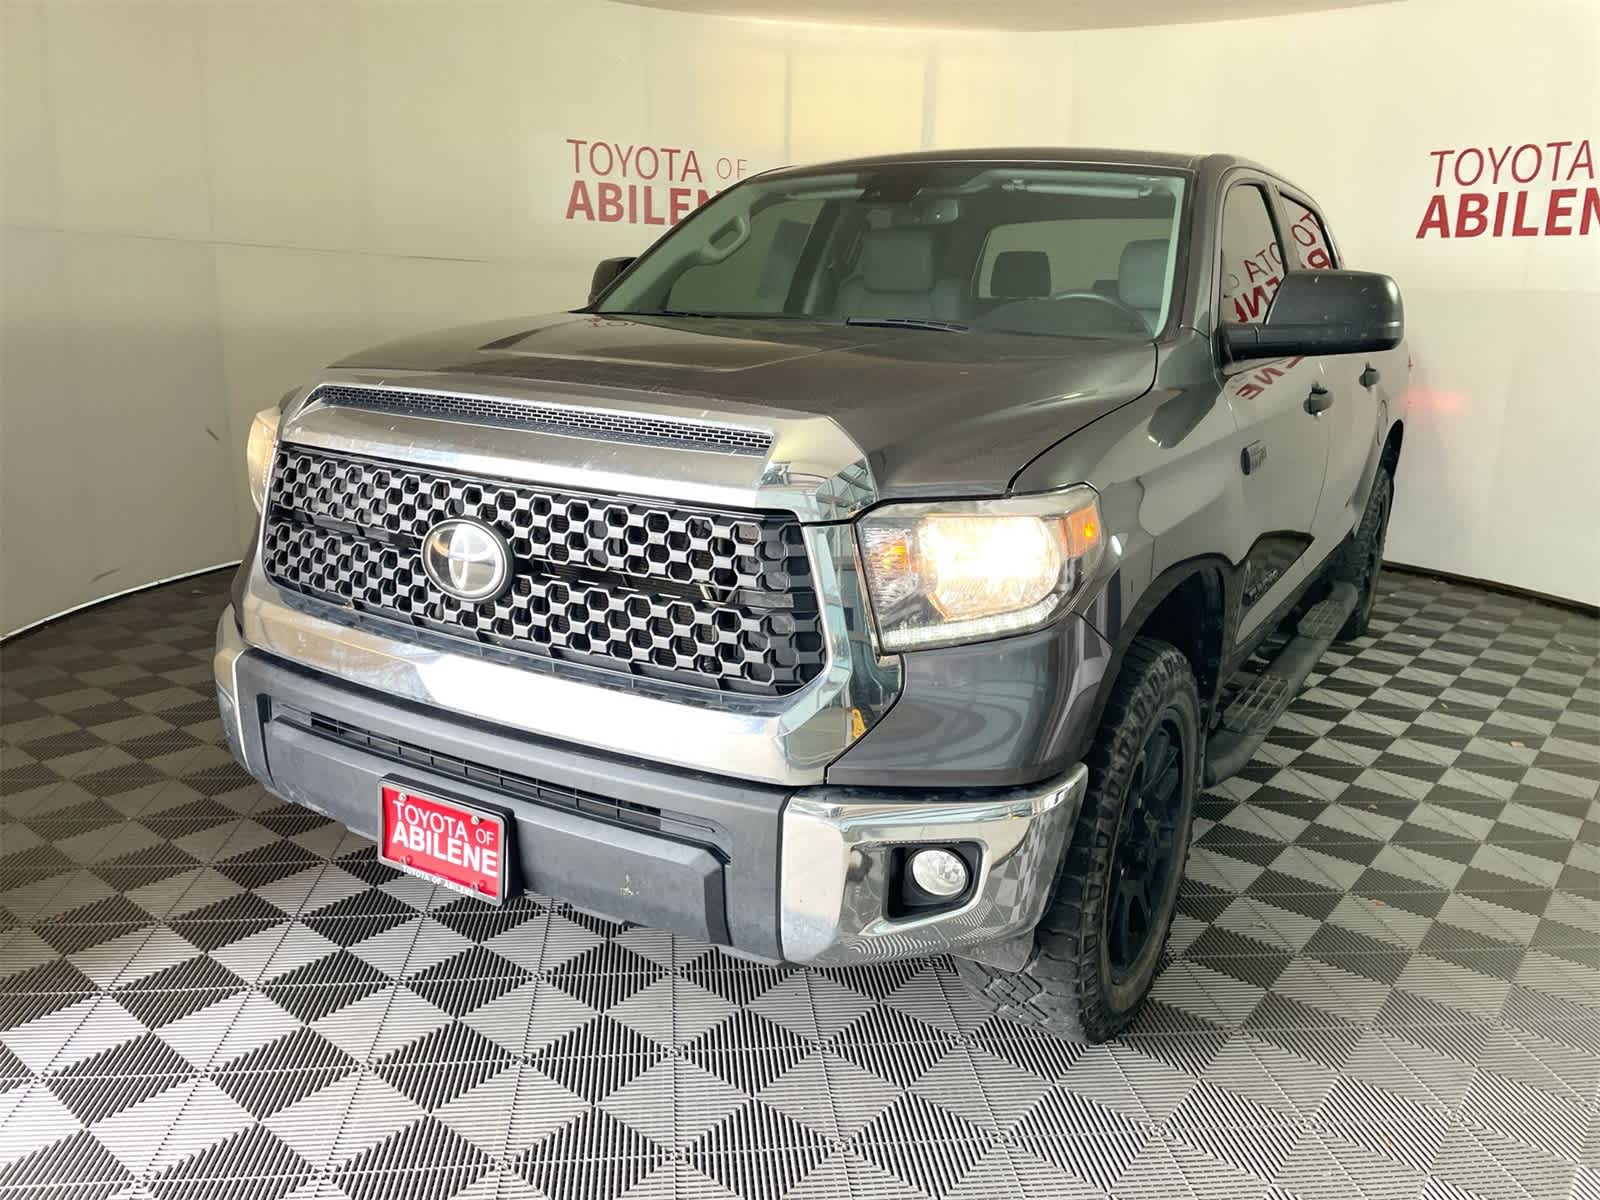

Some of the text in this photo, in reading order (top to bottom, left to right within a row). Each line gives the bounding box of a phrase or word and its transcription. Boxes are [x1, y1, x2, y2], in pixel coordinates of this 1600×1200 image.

[566, 138, 748, 183] TOYOTA OF
[1430, 139, 1595, 188] TOYOTA
[392, 799, 495, 846] TOYOTA OF
[391, 821, 498, 878] ABILENE
[402, 864, 430, 881] TOYOTA
